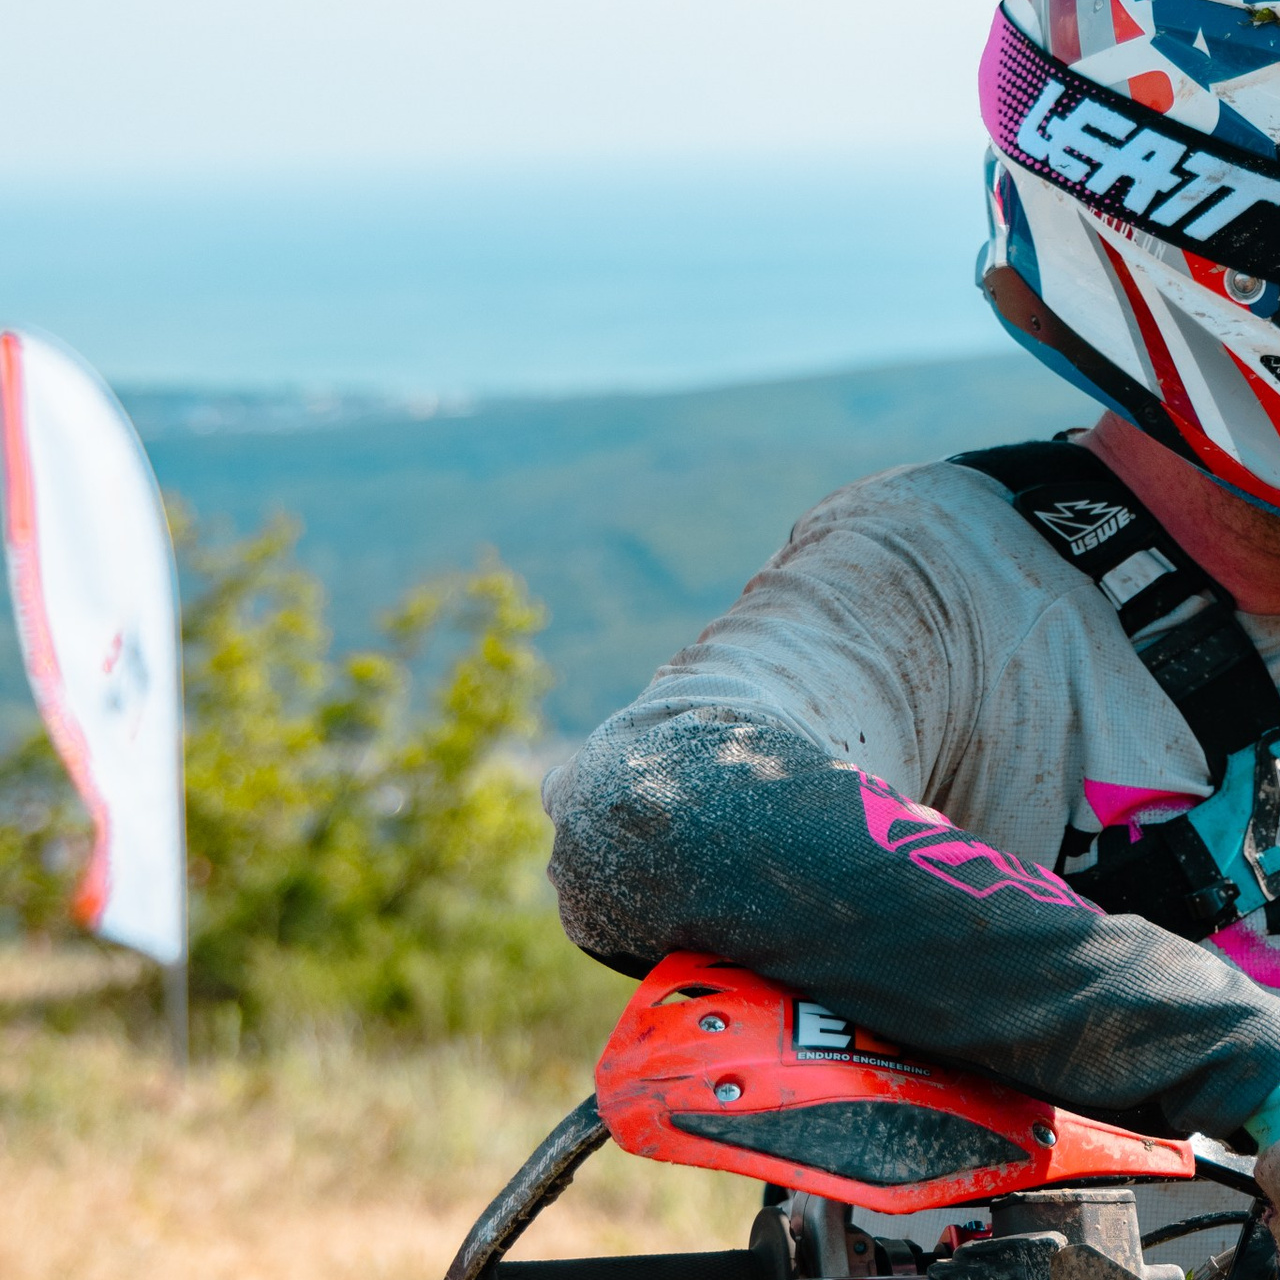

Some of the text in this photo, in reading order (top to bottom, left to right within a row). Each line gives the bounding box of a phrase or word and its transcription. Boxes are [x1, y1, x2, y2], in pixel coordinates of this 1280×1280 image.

[1070, 508, 1130, 556] USWE
[797, 1051, 931, 1076] ENDURO ENGINEERING
